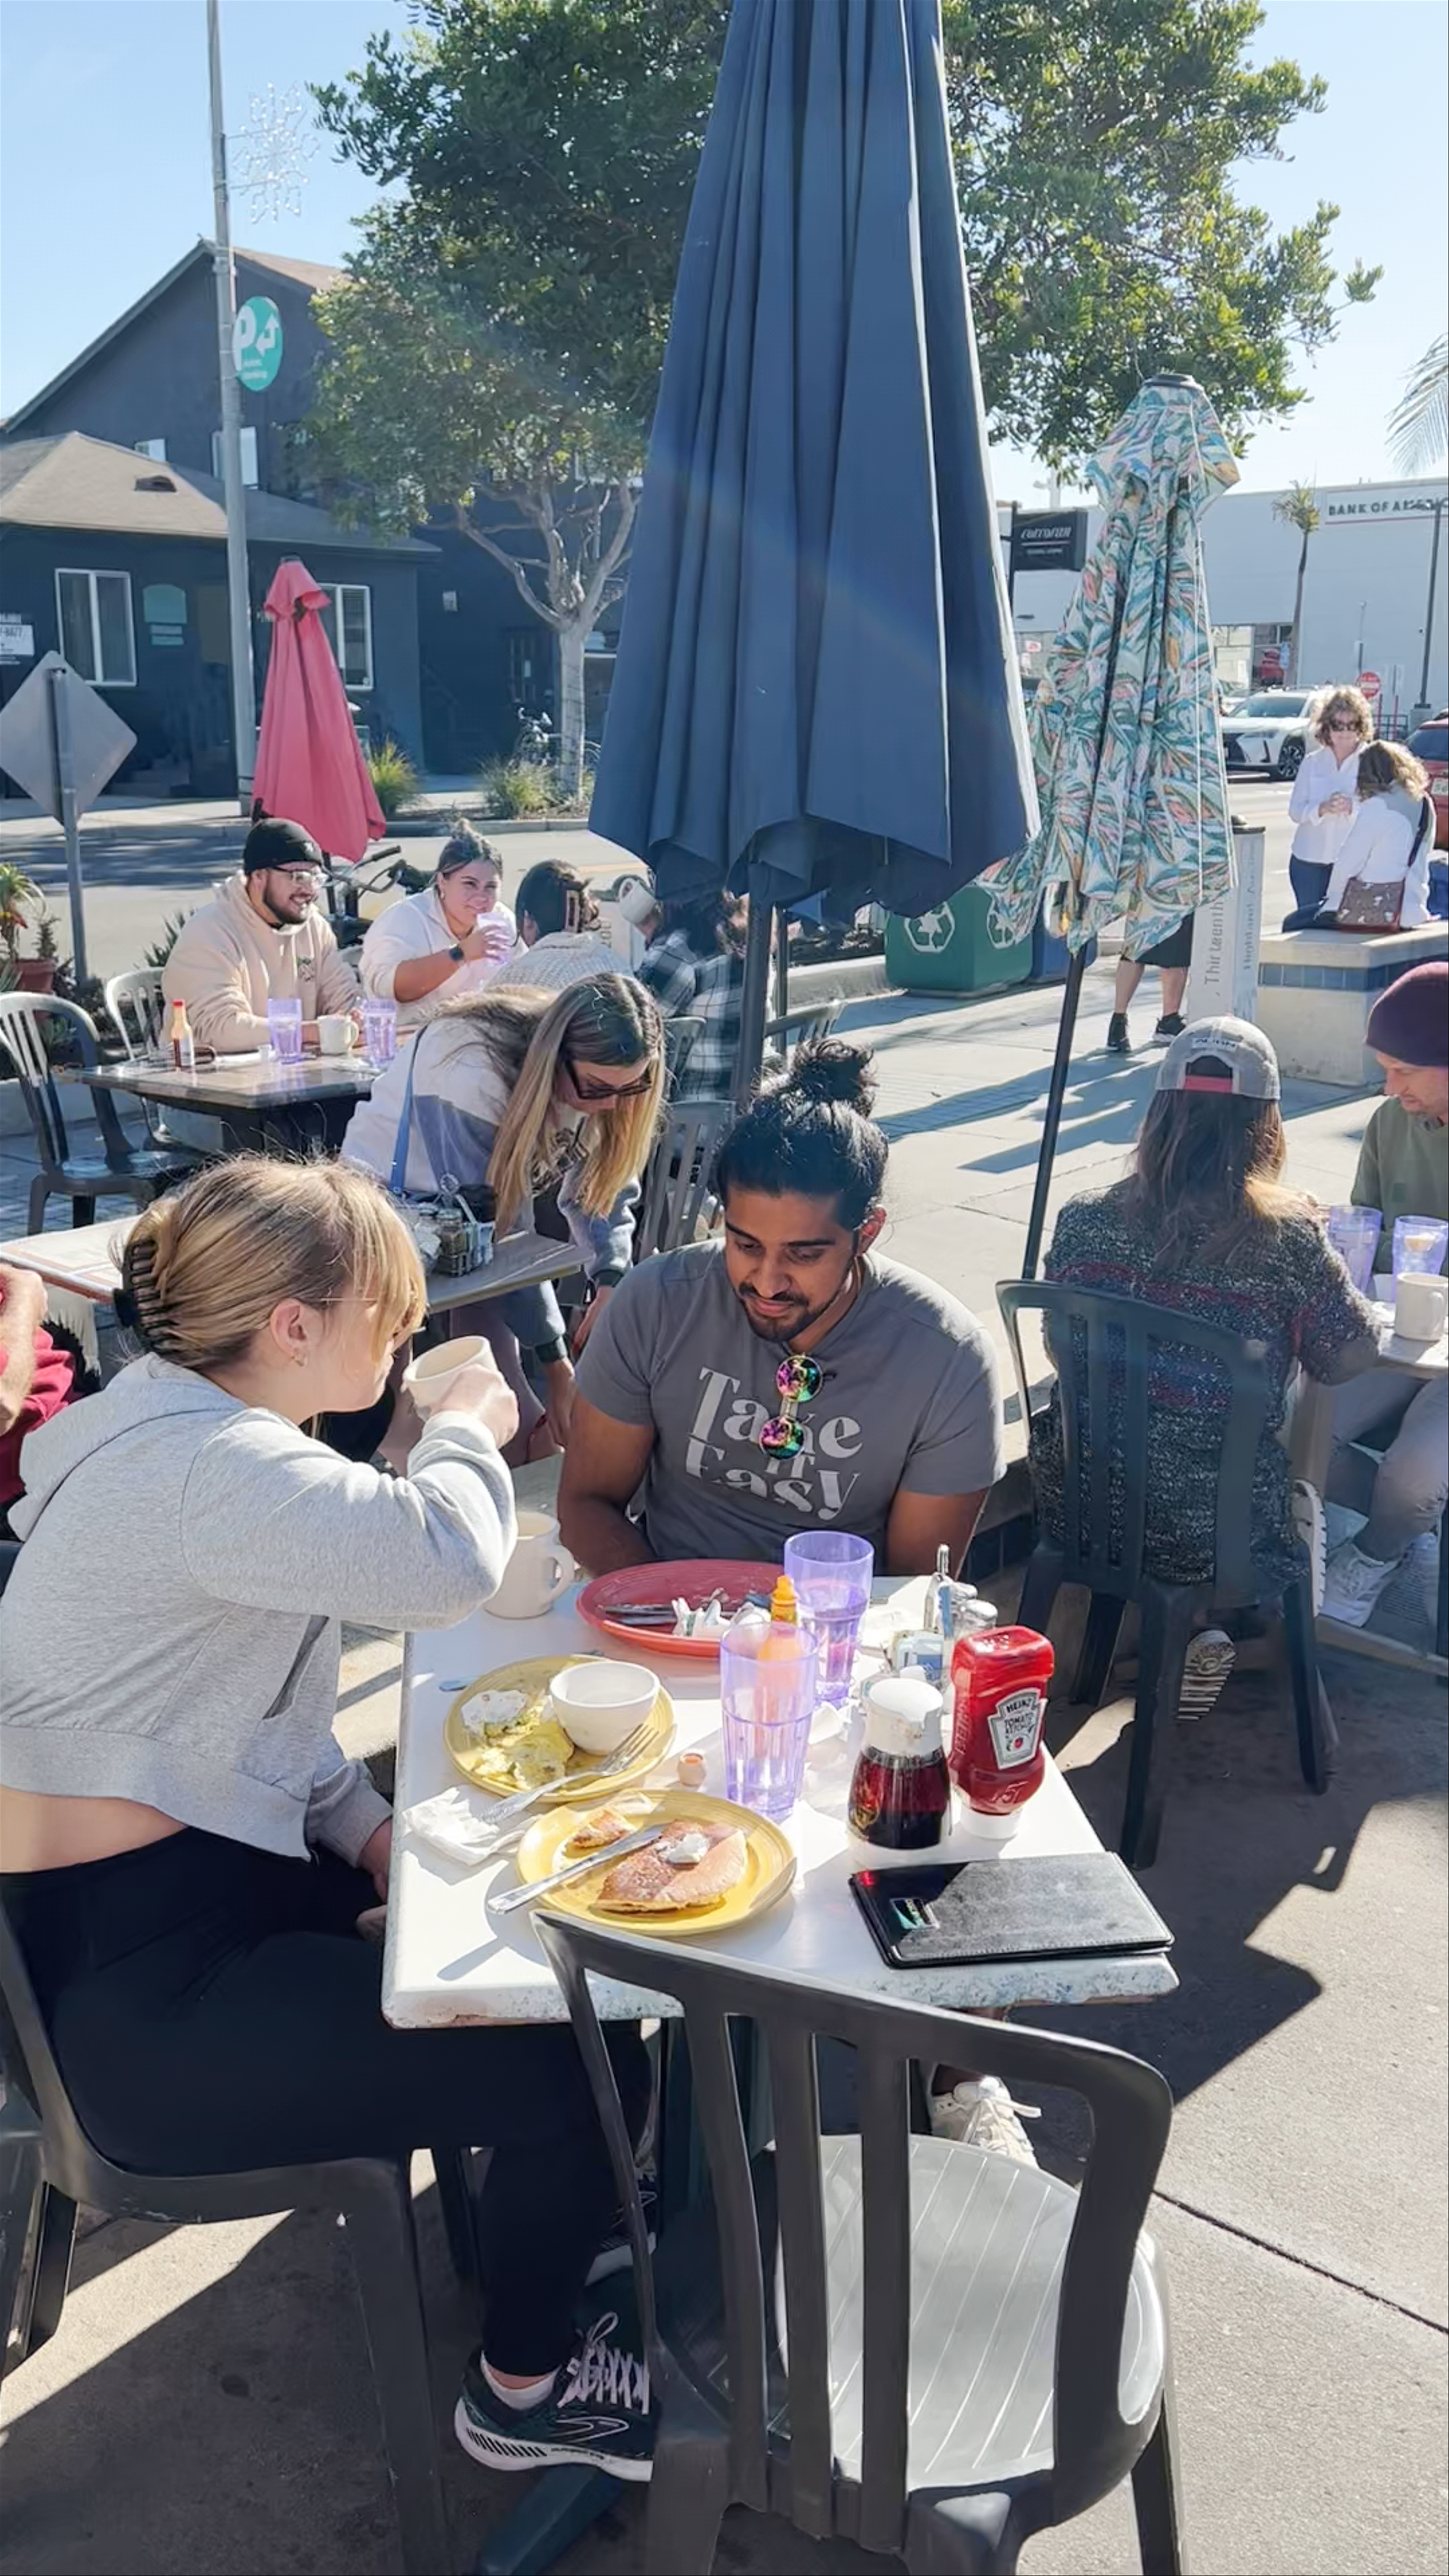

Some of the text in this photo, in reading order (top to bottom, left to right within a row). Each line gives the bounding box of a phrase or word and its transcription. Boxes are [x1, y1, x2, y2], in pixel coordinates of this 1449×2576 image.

[232, 305, 257, 371] P
[1329, 504, 1366, 516] BANK
[1371, 501, 1389, 513] OF
[1204, 901, 1224, 985] Thirteenth
[1006, 1698, 1032, 1713] HEINZ
[1004, 1711, 1035, 1727] TOMATO
